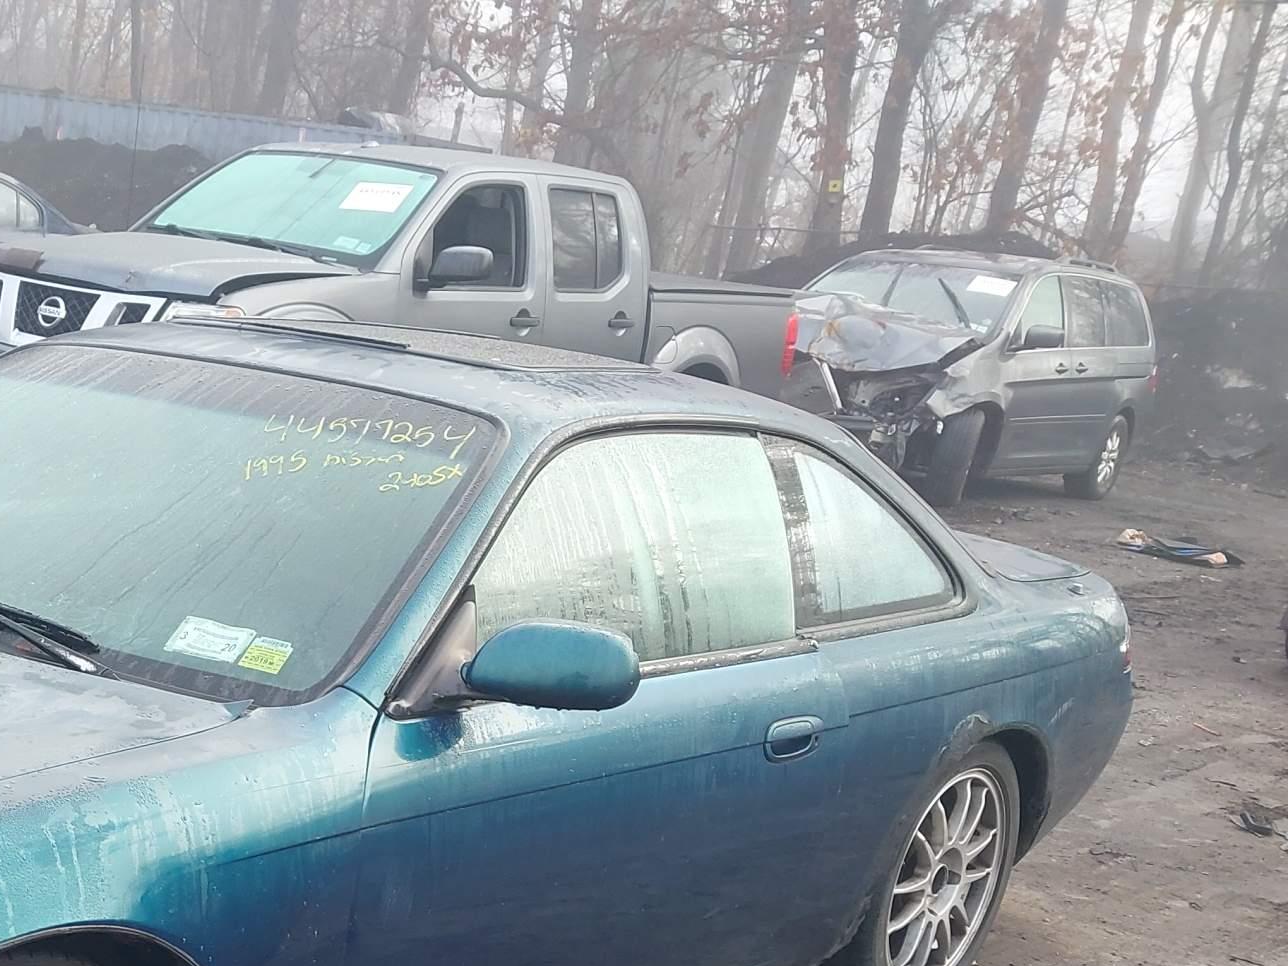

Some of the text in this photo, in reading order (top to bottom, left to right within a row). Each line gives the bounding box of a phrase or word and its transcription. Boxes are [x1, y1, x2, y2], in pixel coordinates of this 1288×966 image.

[39, 306, 61, 316] NISSAN
[264, 414, 476, 459] 44577254
[244, 449, 308, 480] 1995
